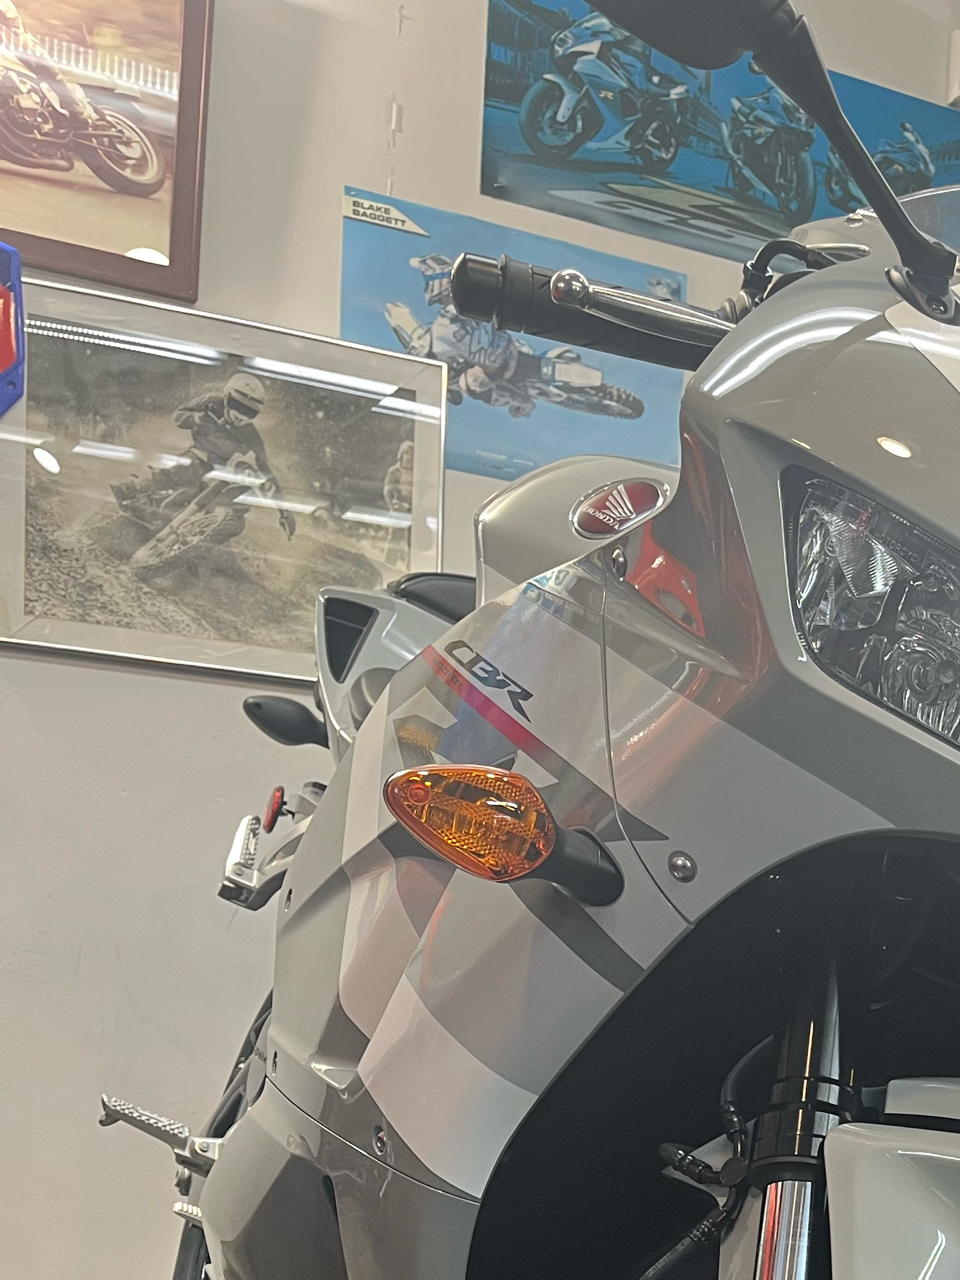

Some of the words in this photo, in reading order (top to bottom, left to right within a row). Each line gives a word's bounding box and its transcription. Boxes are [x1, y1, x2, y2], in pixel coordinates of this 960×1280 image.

[352, 200, 391, 215] BLAKE
[352, 209, 406, 227] BAGGETT
[444, 640, 534, 723] CBR
